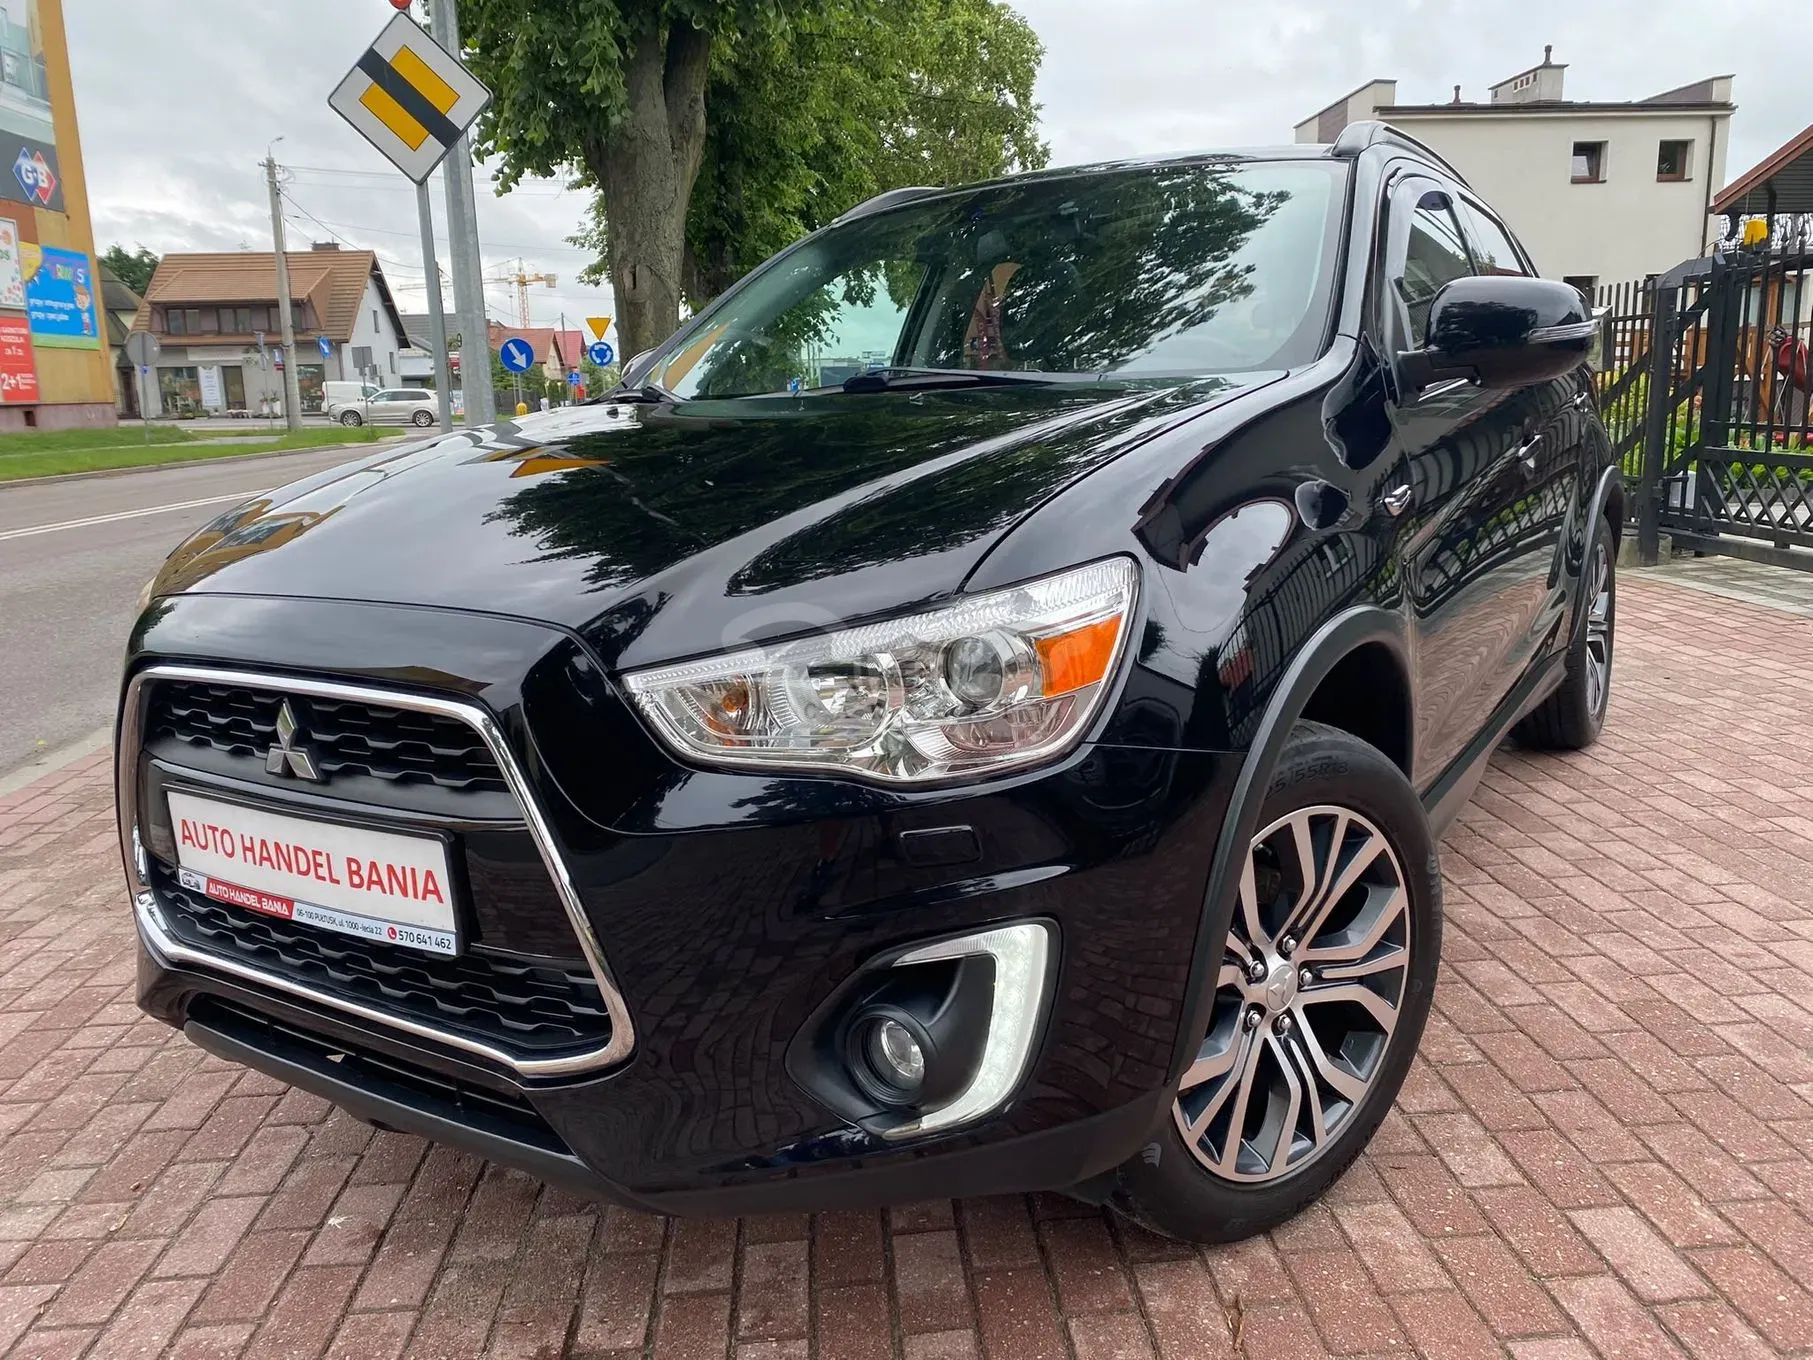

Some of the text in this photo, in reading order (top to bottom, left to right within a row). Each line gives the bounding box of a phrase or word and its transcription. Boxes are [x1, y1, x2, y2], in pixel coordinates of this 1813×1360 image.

[180, 819, 444, 904] AUTO HANDEL BANIA
[208, 883, 289, 915] AUTO HANDEL BANIA
[374, 926, 383, 936] 22
[398, 929, 452, 950] 570 641 462
